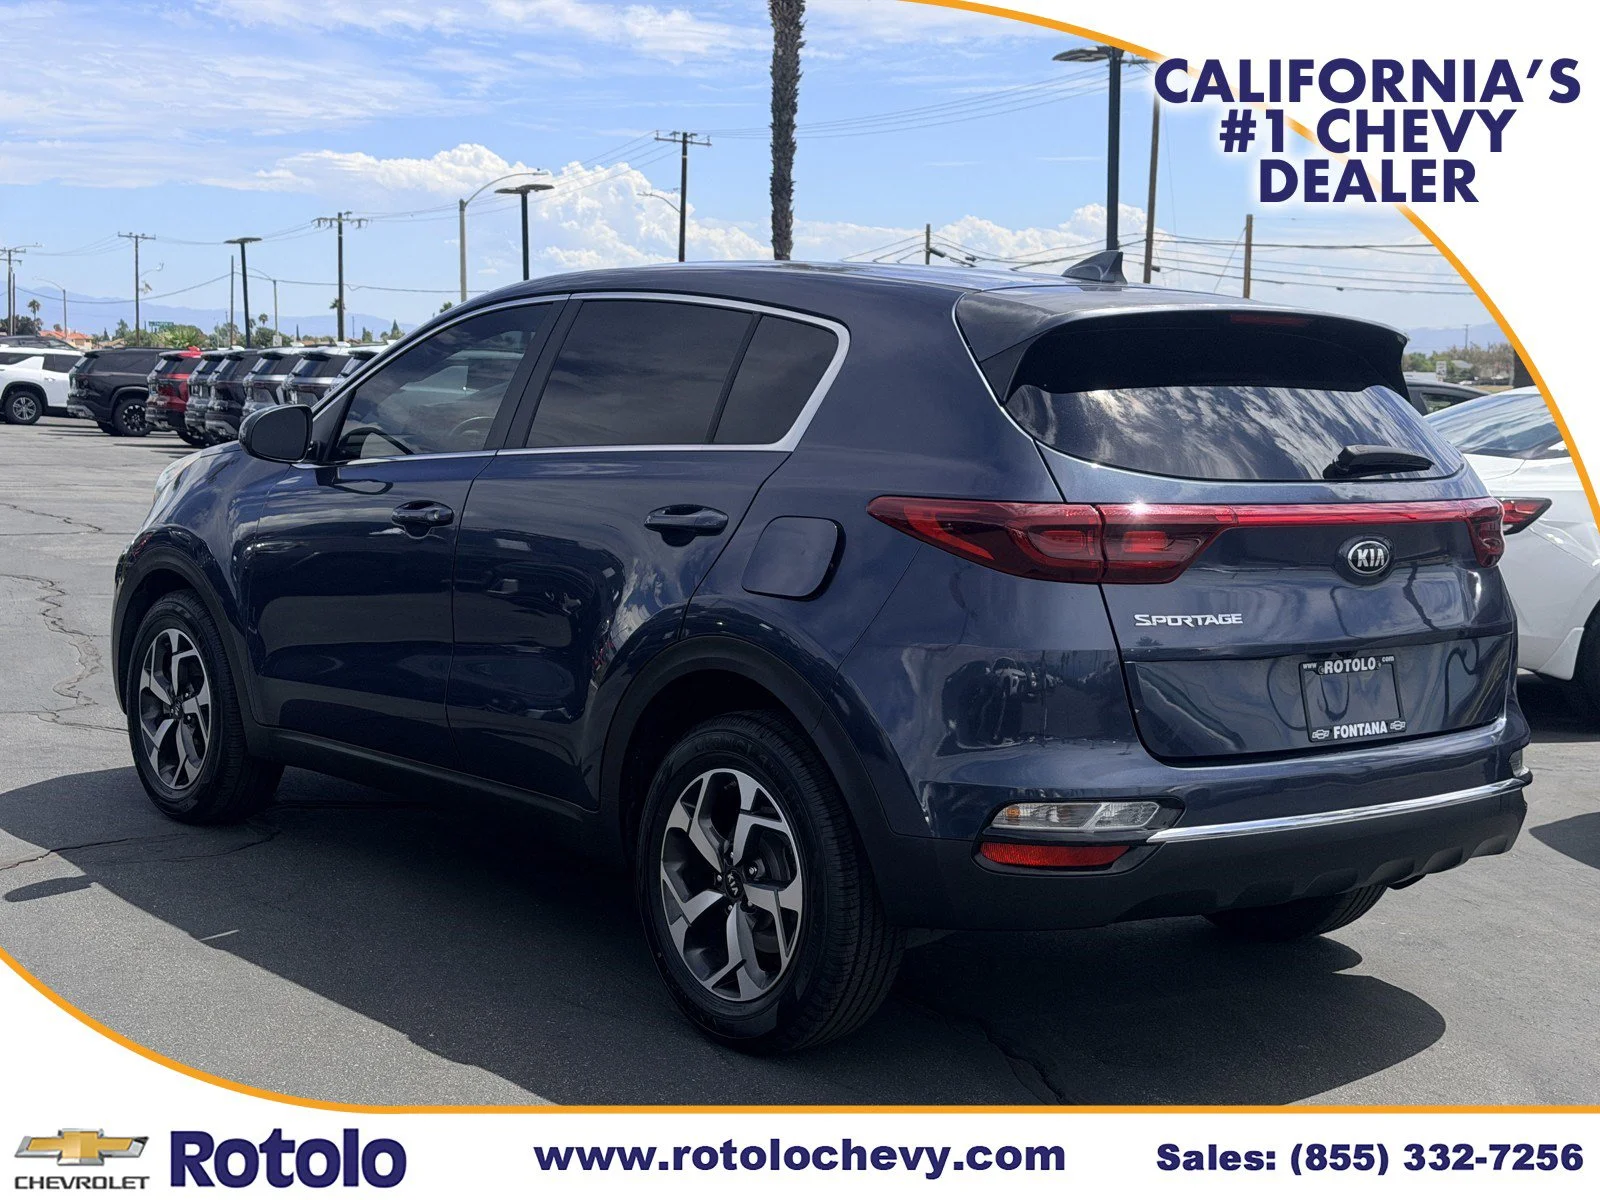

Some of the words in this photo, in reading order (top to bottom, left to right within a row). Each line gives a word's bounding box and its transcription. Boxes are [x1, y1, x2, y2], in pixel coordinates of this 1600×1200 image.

[1357, 548, 1385, 567] KIA
[1134, 613, 1243, 627] SPORTAGE
[1324, 657, 1376, 674] ROTOLO
[1333, 721, 1388, 739] FONTANA
